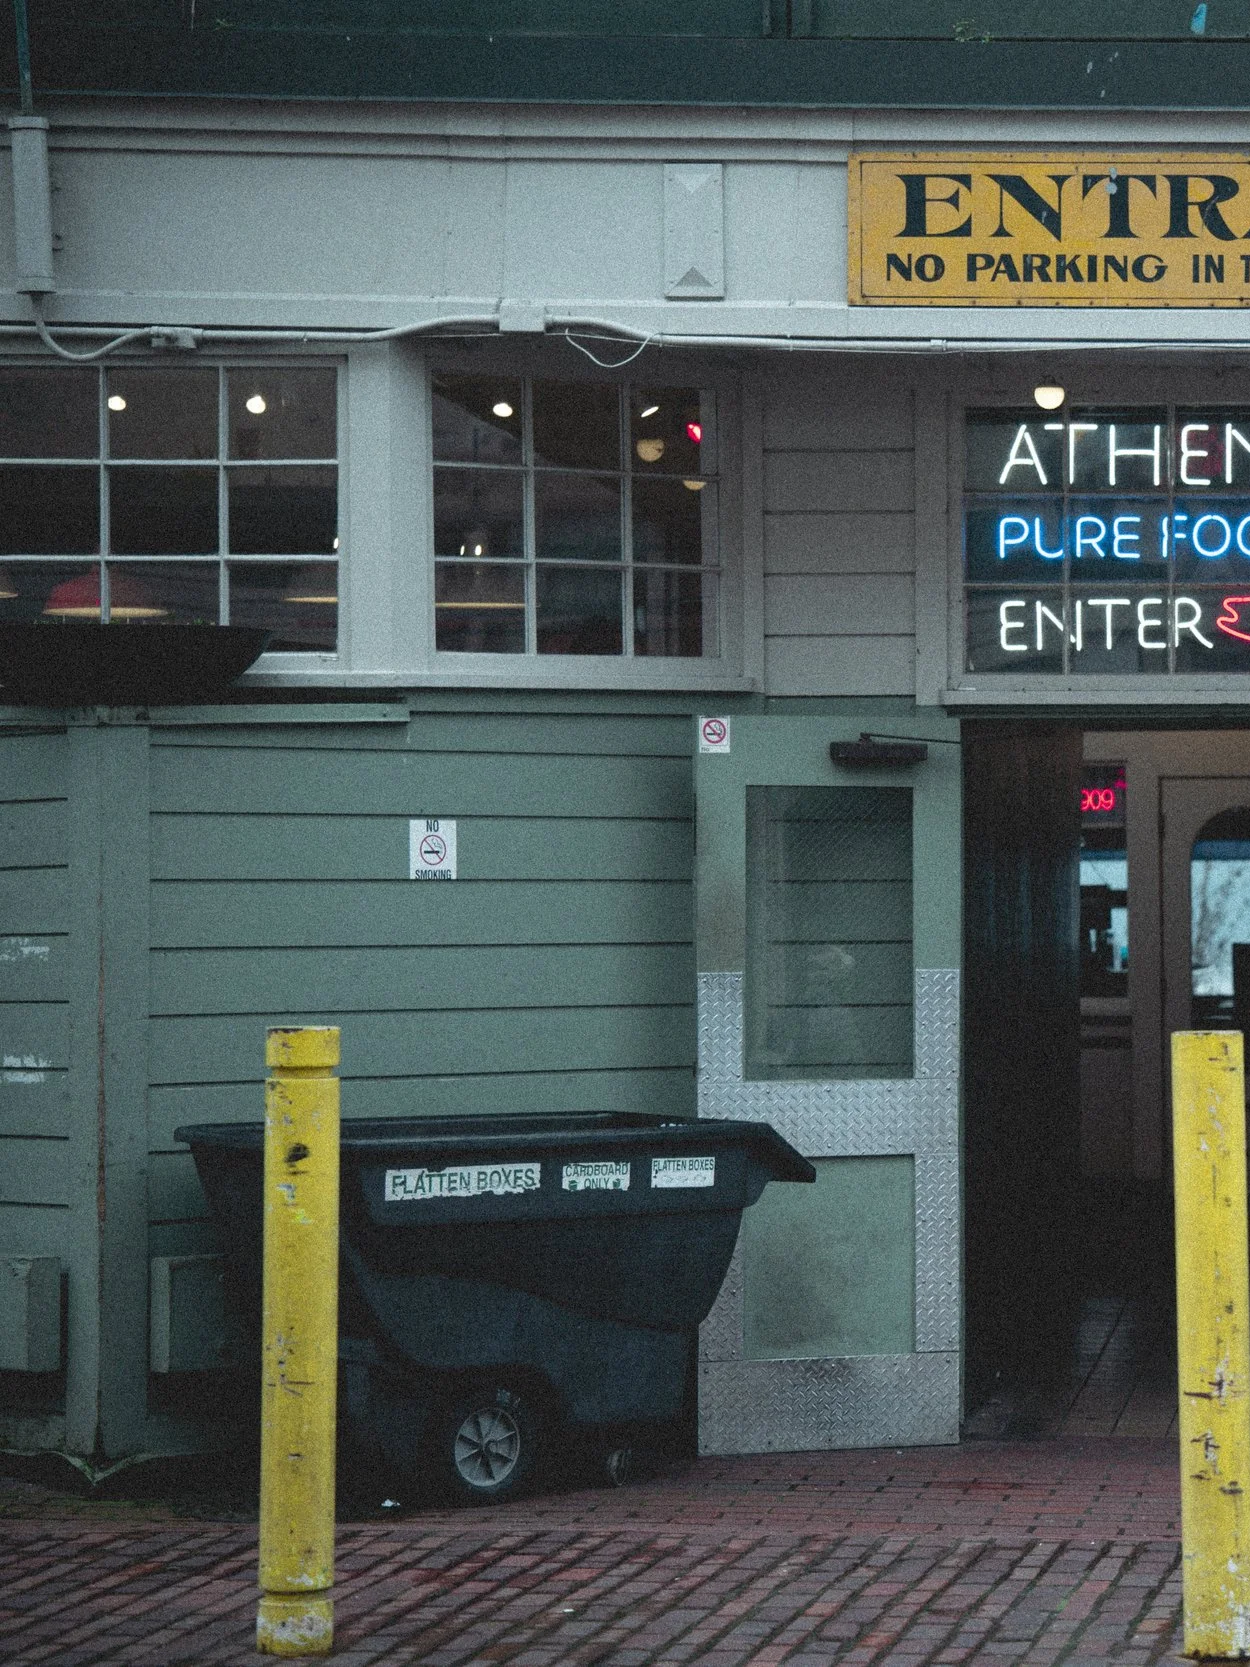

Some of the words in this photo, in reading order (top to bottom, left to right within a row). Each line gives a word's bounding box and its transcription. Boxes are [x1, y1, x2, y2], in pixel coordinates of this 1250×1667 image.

[886, 253, 945, 282] NO
[966, 253, 1168, 283] PARKING
[1192, 254, 1224, 284] IN
[998, 515, 1141, 559] PURE
[999, 597, 1214, 651] ENTER
[426, 820, 440, 832] NO
[415, 869, 452, 880] SMOKING
[565, 1164, 628, 1177] CARDBOARD
[653, 1160, 687, 1171] FLATTEN
[688, 1159, 715, 1171] BOXES
[391, 1170, 471, 1194] FLATTEN
[477, 1167, 536, 1190] BOXES
[584, 1178, 609, 1189] ONLY
